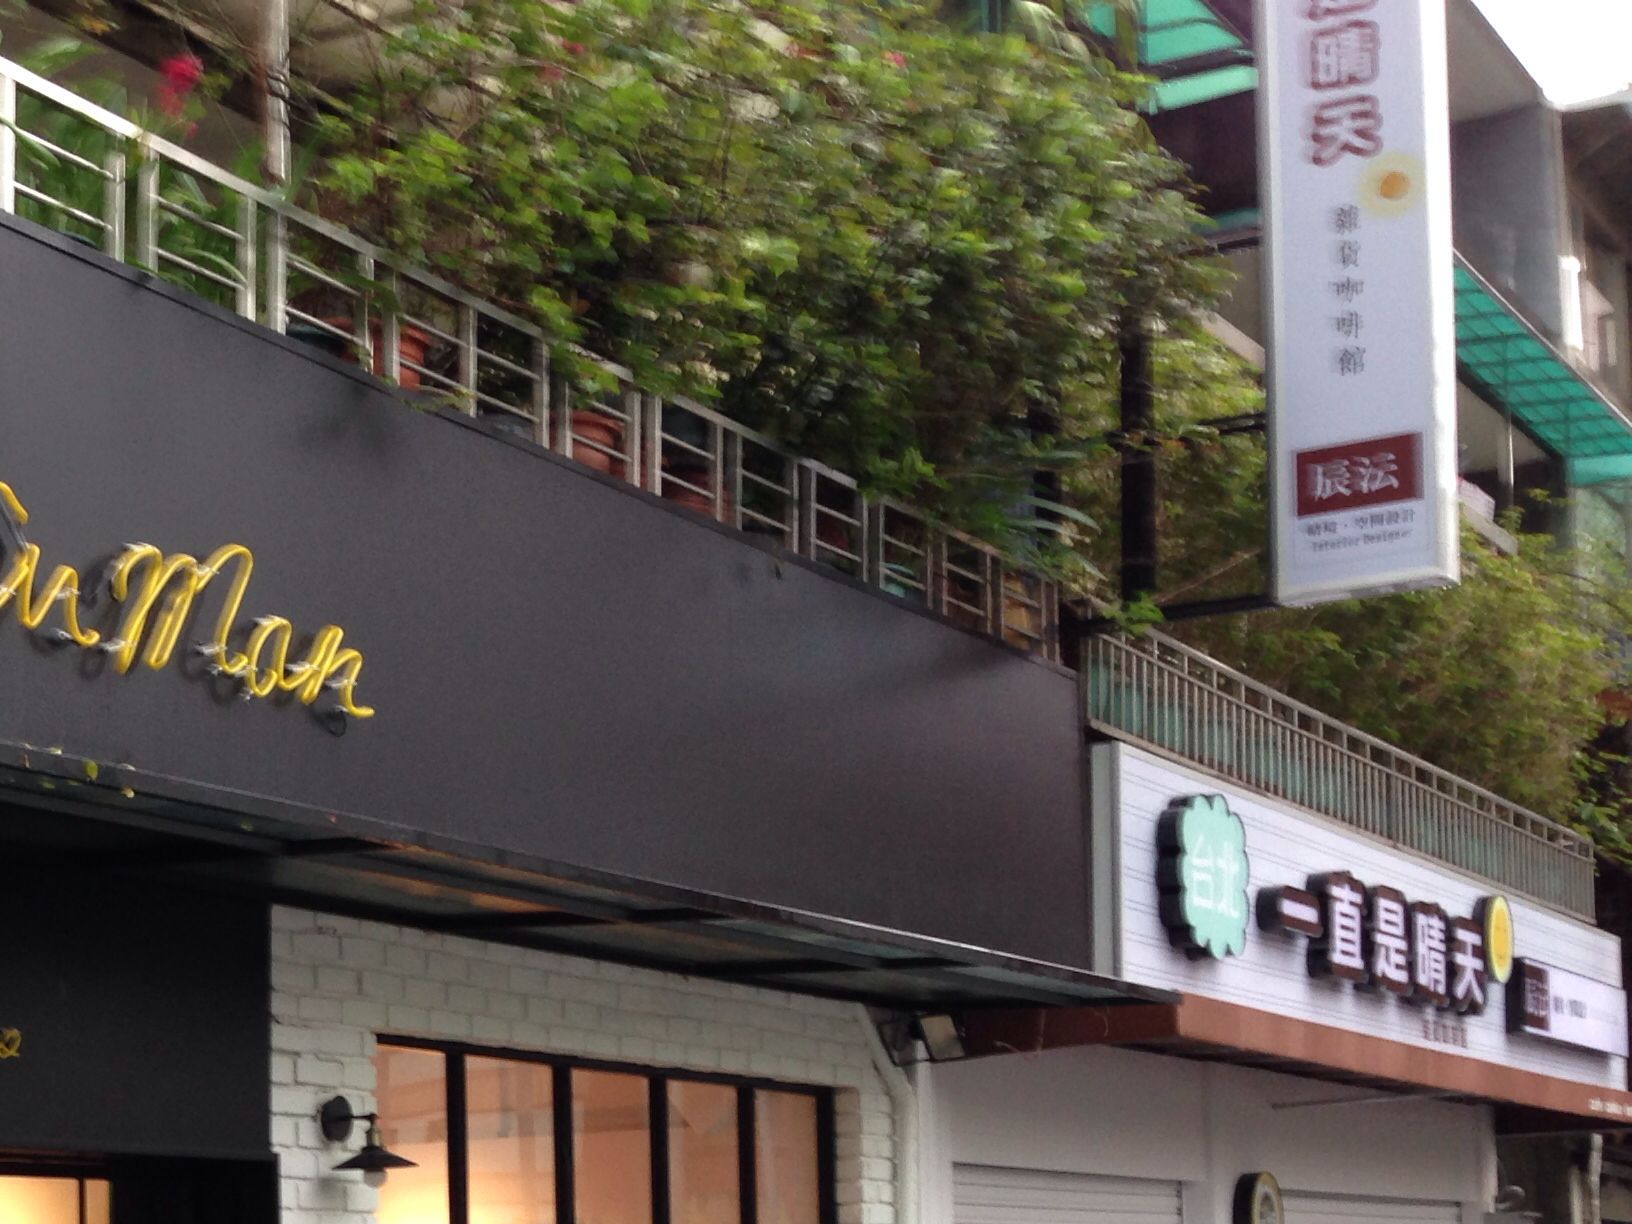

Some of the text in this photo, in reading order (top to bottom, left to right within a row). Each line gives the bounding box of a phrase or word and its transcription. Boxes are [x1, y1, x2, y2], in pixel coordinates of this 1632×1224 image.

[110, 540, 375, 719] Man
[1278, 882, 1486, 1004] 一直是晴天
